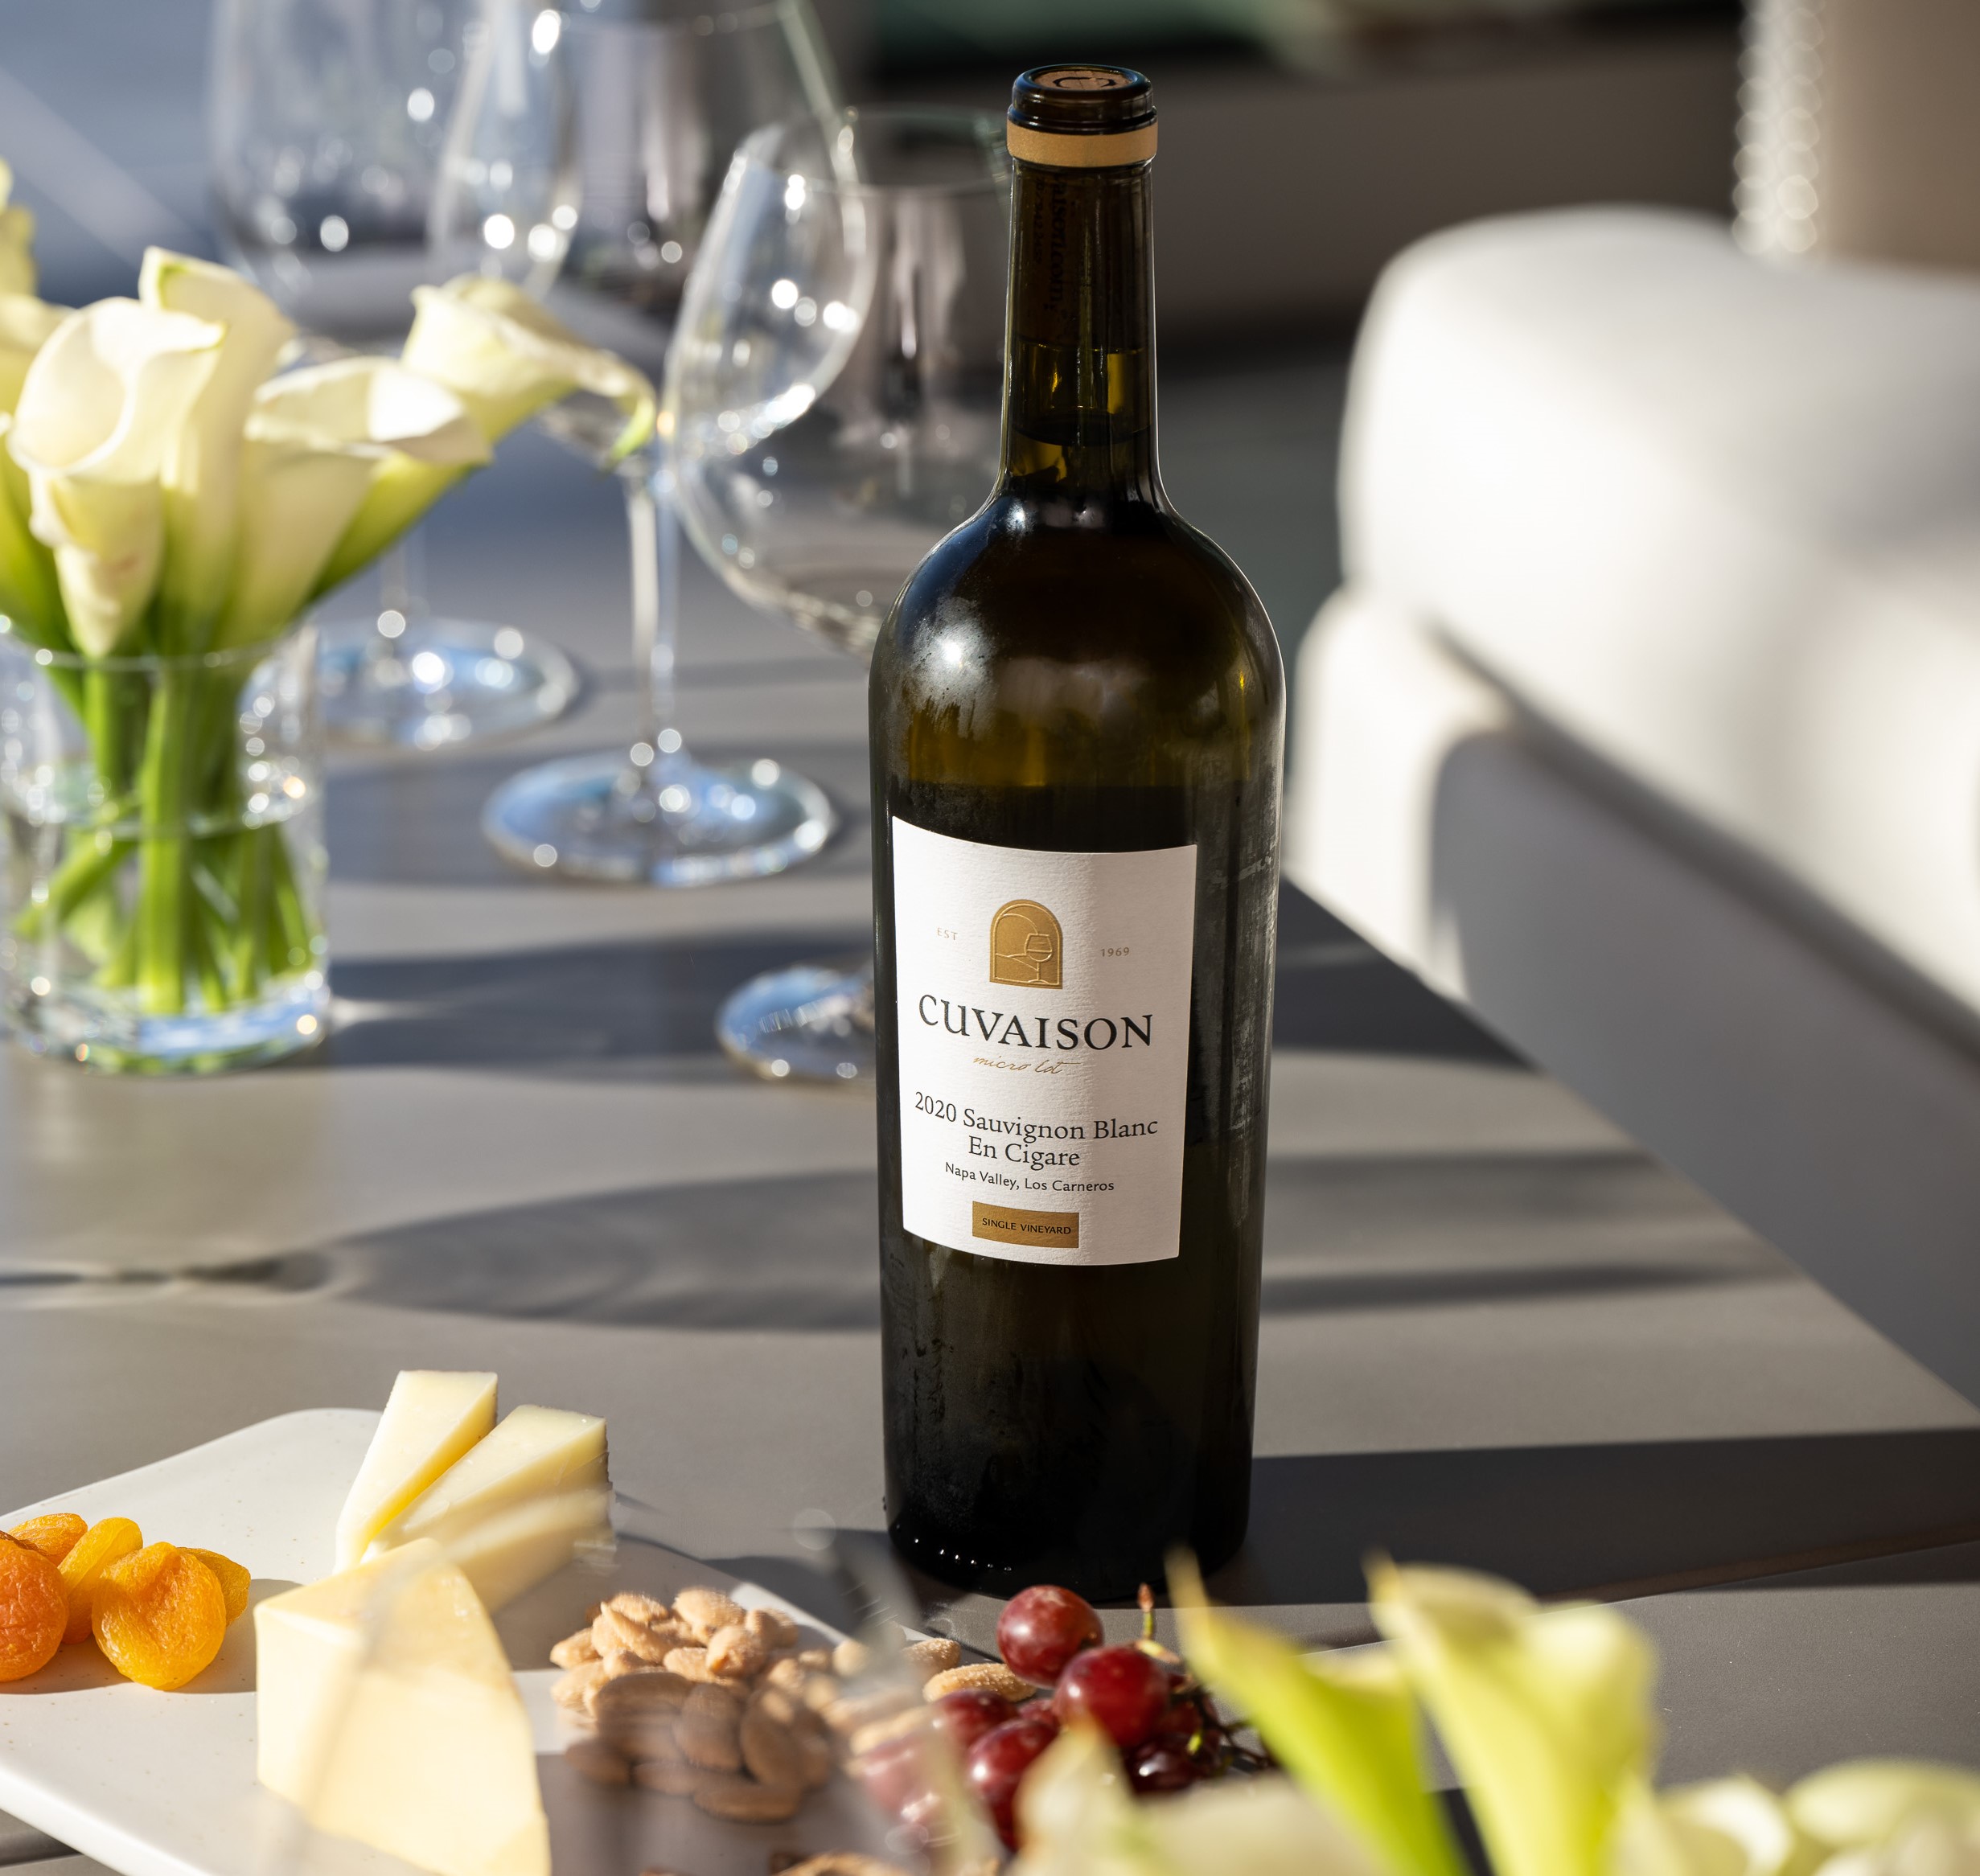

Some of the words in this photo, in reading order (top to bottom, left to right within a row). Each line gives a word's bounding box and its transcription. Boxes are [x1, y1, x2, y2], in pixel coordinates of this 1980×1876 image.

[937, 927, 958, 941] EST
[1100, 946, 1130, 958] 1969
[918, 994, 1153, 1050] CUVAISON
[973, 1055, 1032, 1071] micro
[1034, 1059, 1082, 1075] lot
[915, 1091, 956, 1123] 2020
[963, 1108, 1086, 1143] Sauvignon
[1093, 1119, 1158, 1139] Blanc
[968, 1135, 997, 1160] En
[1004, 1143, 1081, 1171] Cigare
[945, 1161, 977, 1181] Napa
[979, 1170, 1020, 1190] Valley,
[1025, 1177, 1048, 1191] Los
[1052, 1179, 1115, 1192] Carneros
[982, 1217, 1017, 1231] SINGLE
[1020, 1223, 1071, 1235] VINEYARD
